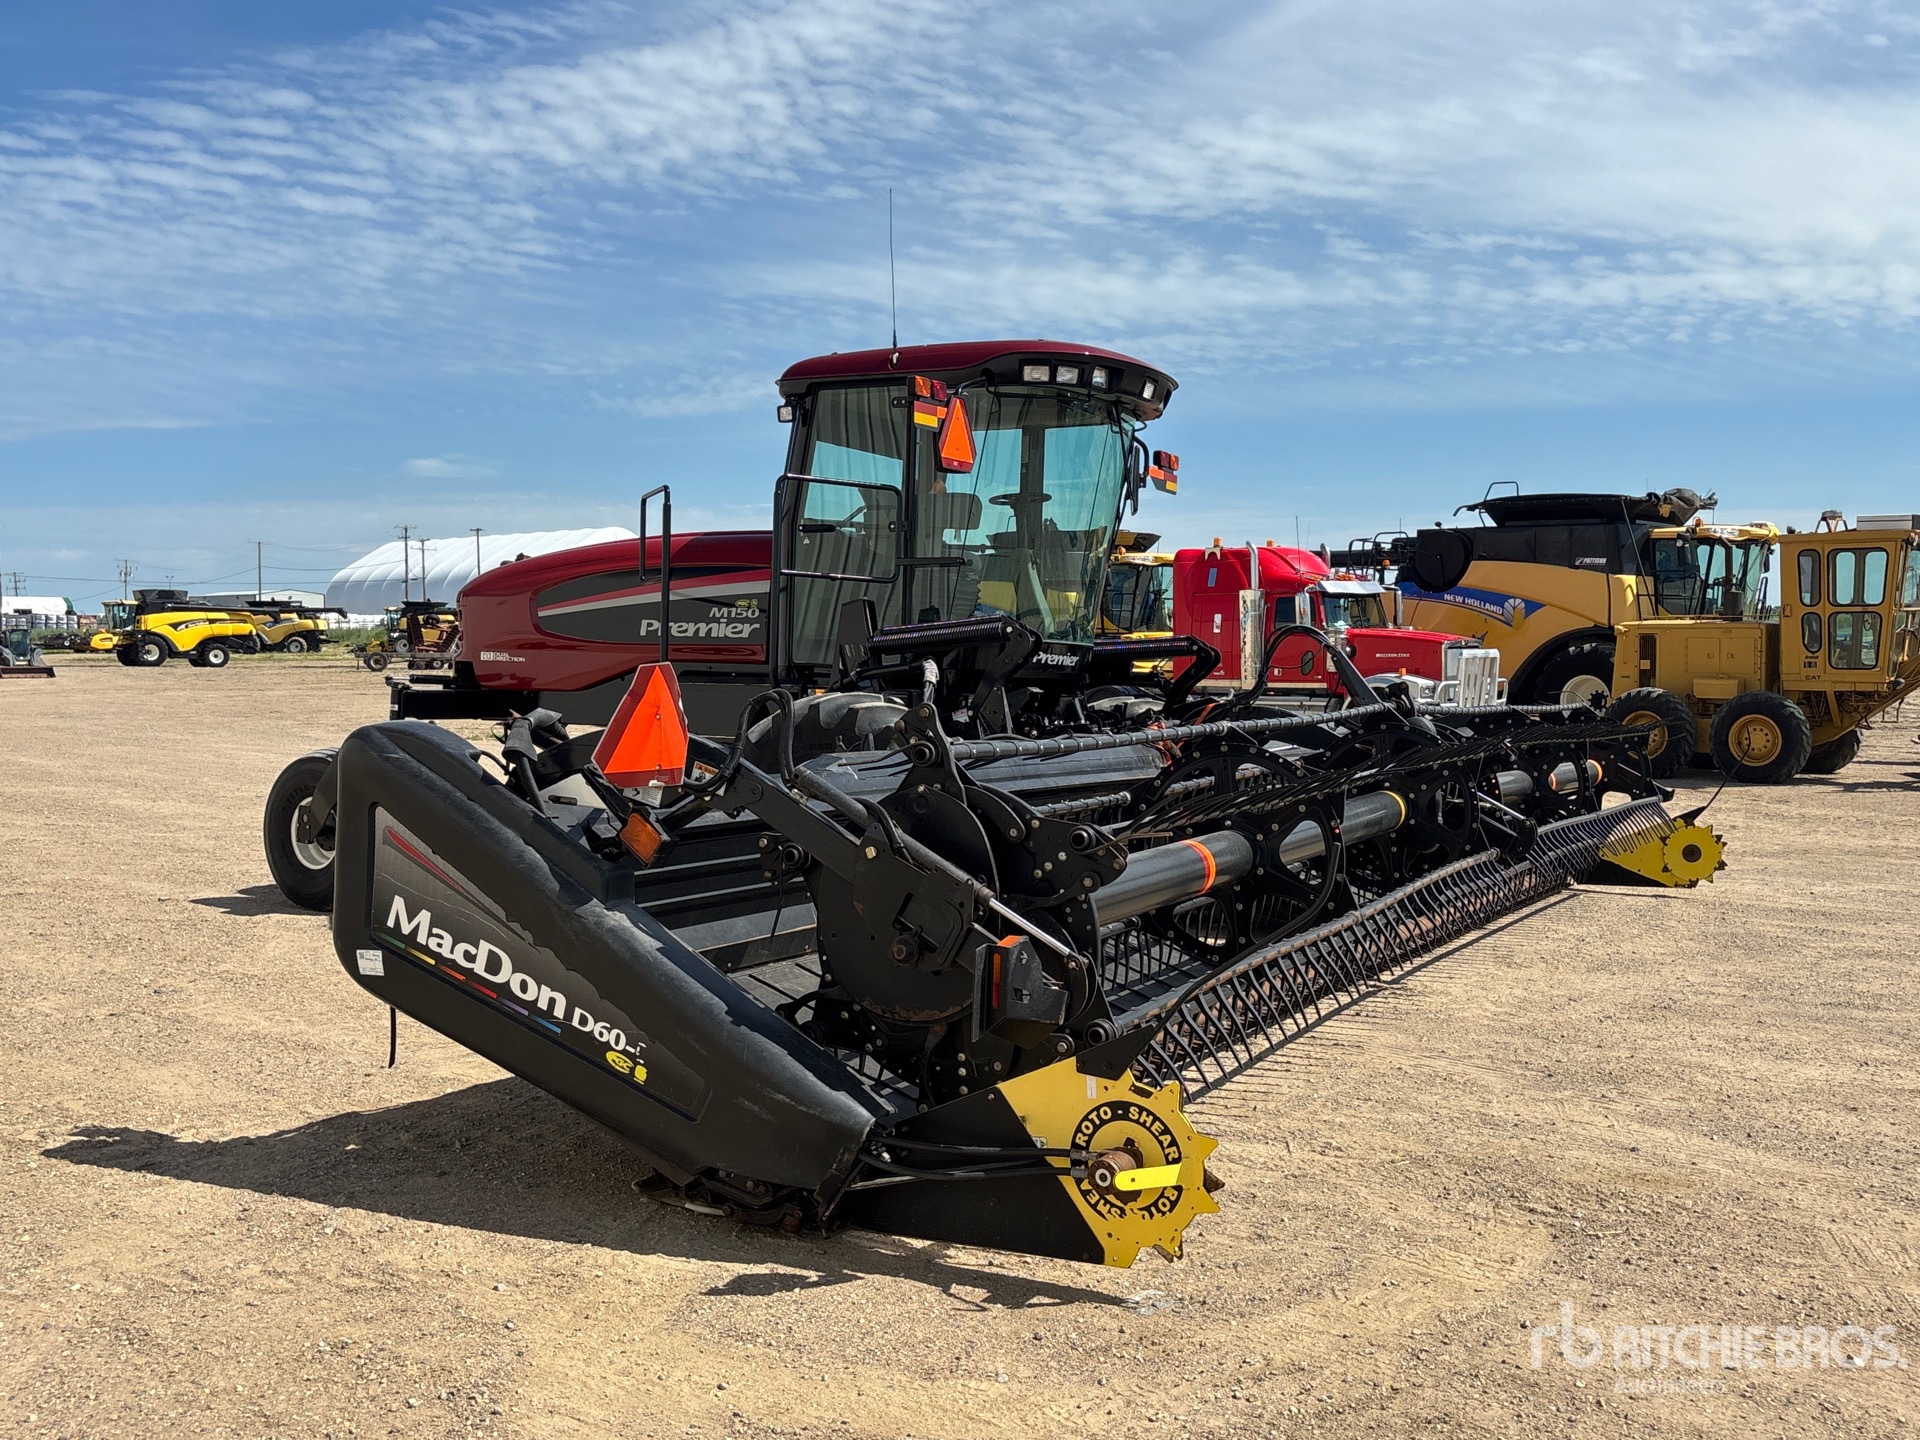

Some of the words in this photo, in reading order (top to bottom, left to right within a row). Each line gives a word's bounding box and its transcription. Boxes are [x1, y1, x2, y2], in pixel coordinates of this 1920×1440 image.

[709, 607, 760, 618] M150
[1444, 593, 1464, 604] NEW
[1465, 597, 1503, 615] HOLLAND
[1032, 651, 1080, 666] Premier
[386, 894, 567, 1020] MacDon
[1075, 1106, 1112, 1147] ROTO
[1128, 1106, 1179, 1162] SHEAR
